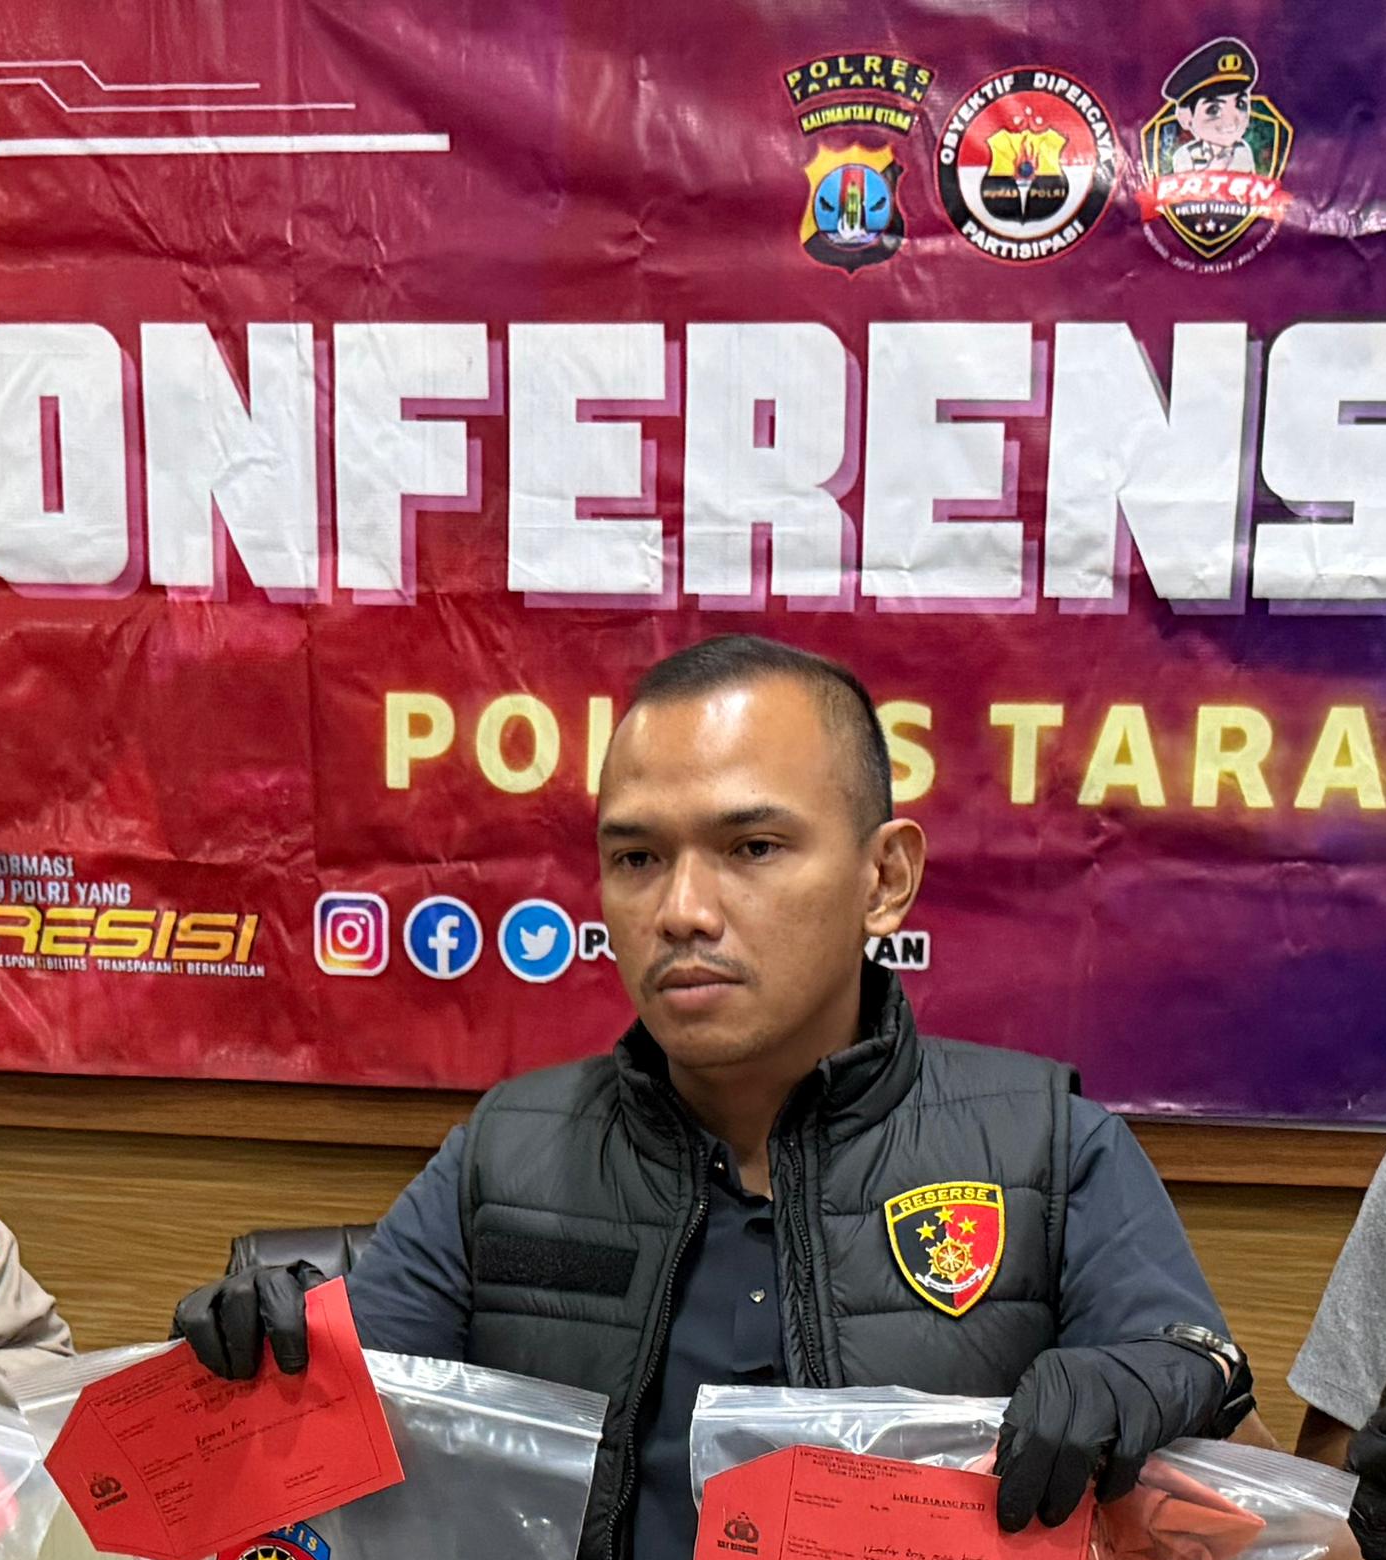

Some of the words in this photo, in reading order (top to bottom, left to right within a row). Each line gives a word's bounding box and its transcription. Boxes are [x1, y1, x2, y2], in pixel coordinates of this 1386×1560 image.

[786, 55, 930, 88] POLRES
[940, 74, 1014, 165] OBYEKTIF
[1033, 72, 1114, 162] DIPERCAYA
[1030, 188, 1066, 198] POLRI
[1157, 175, 1276, 203] PATEN
[962, 220, 1085, 260] PARTISIPASI
[10, 880, 70, 904] POLRI
[74, 882, 131, 906] YANG
[898, 1187, 990, 1214] RESERSE
